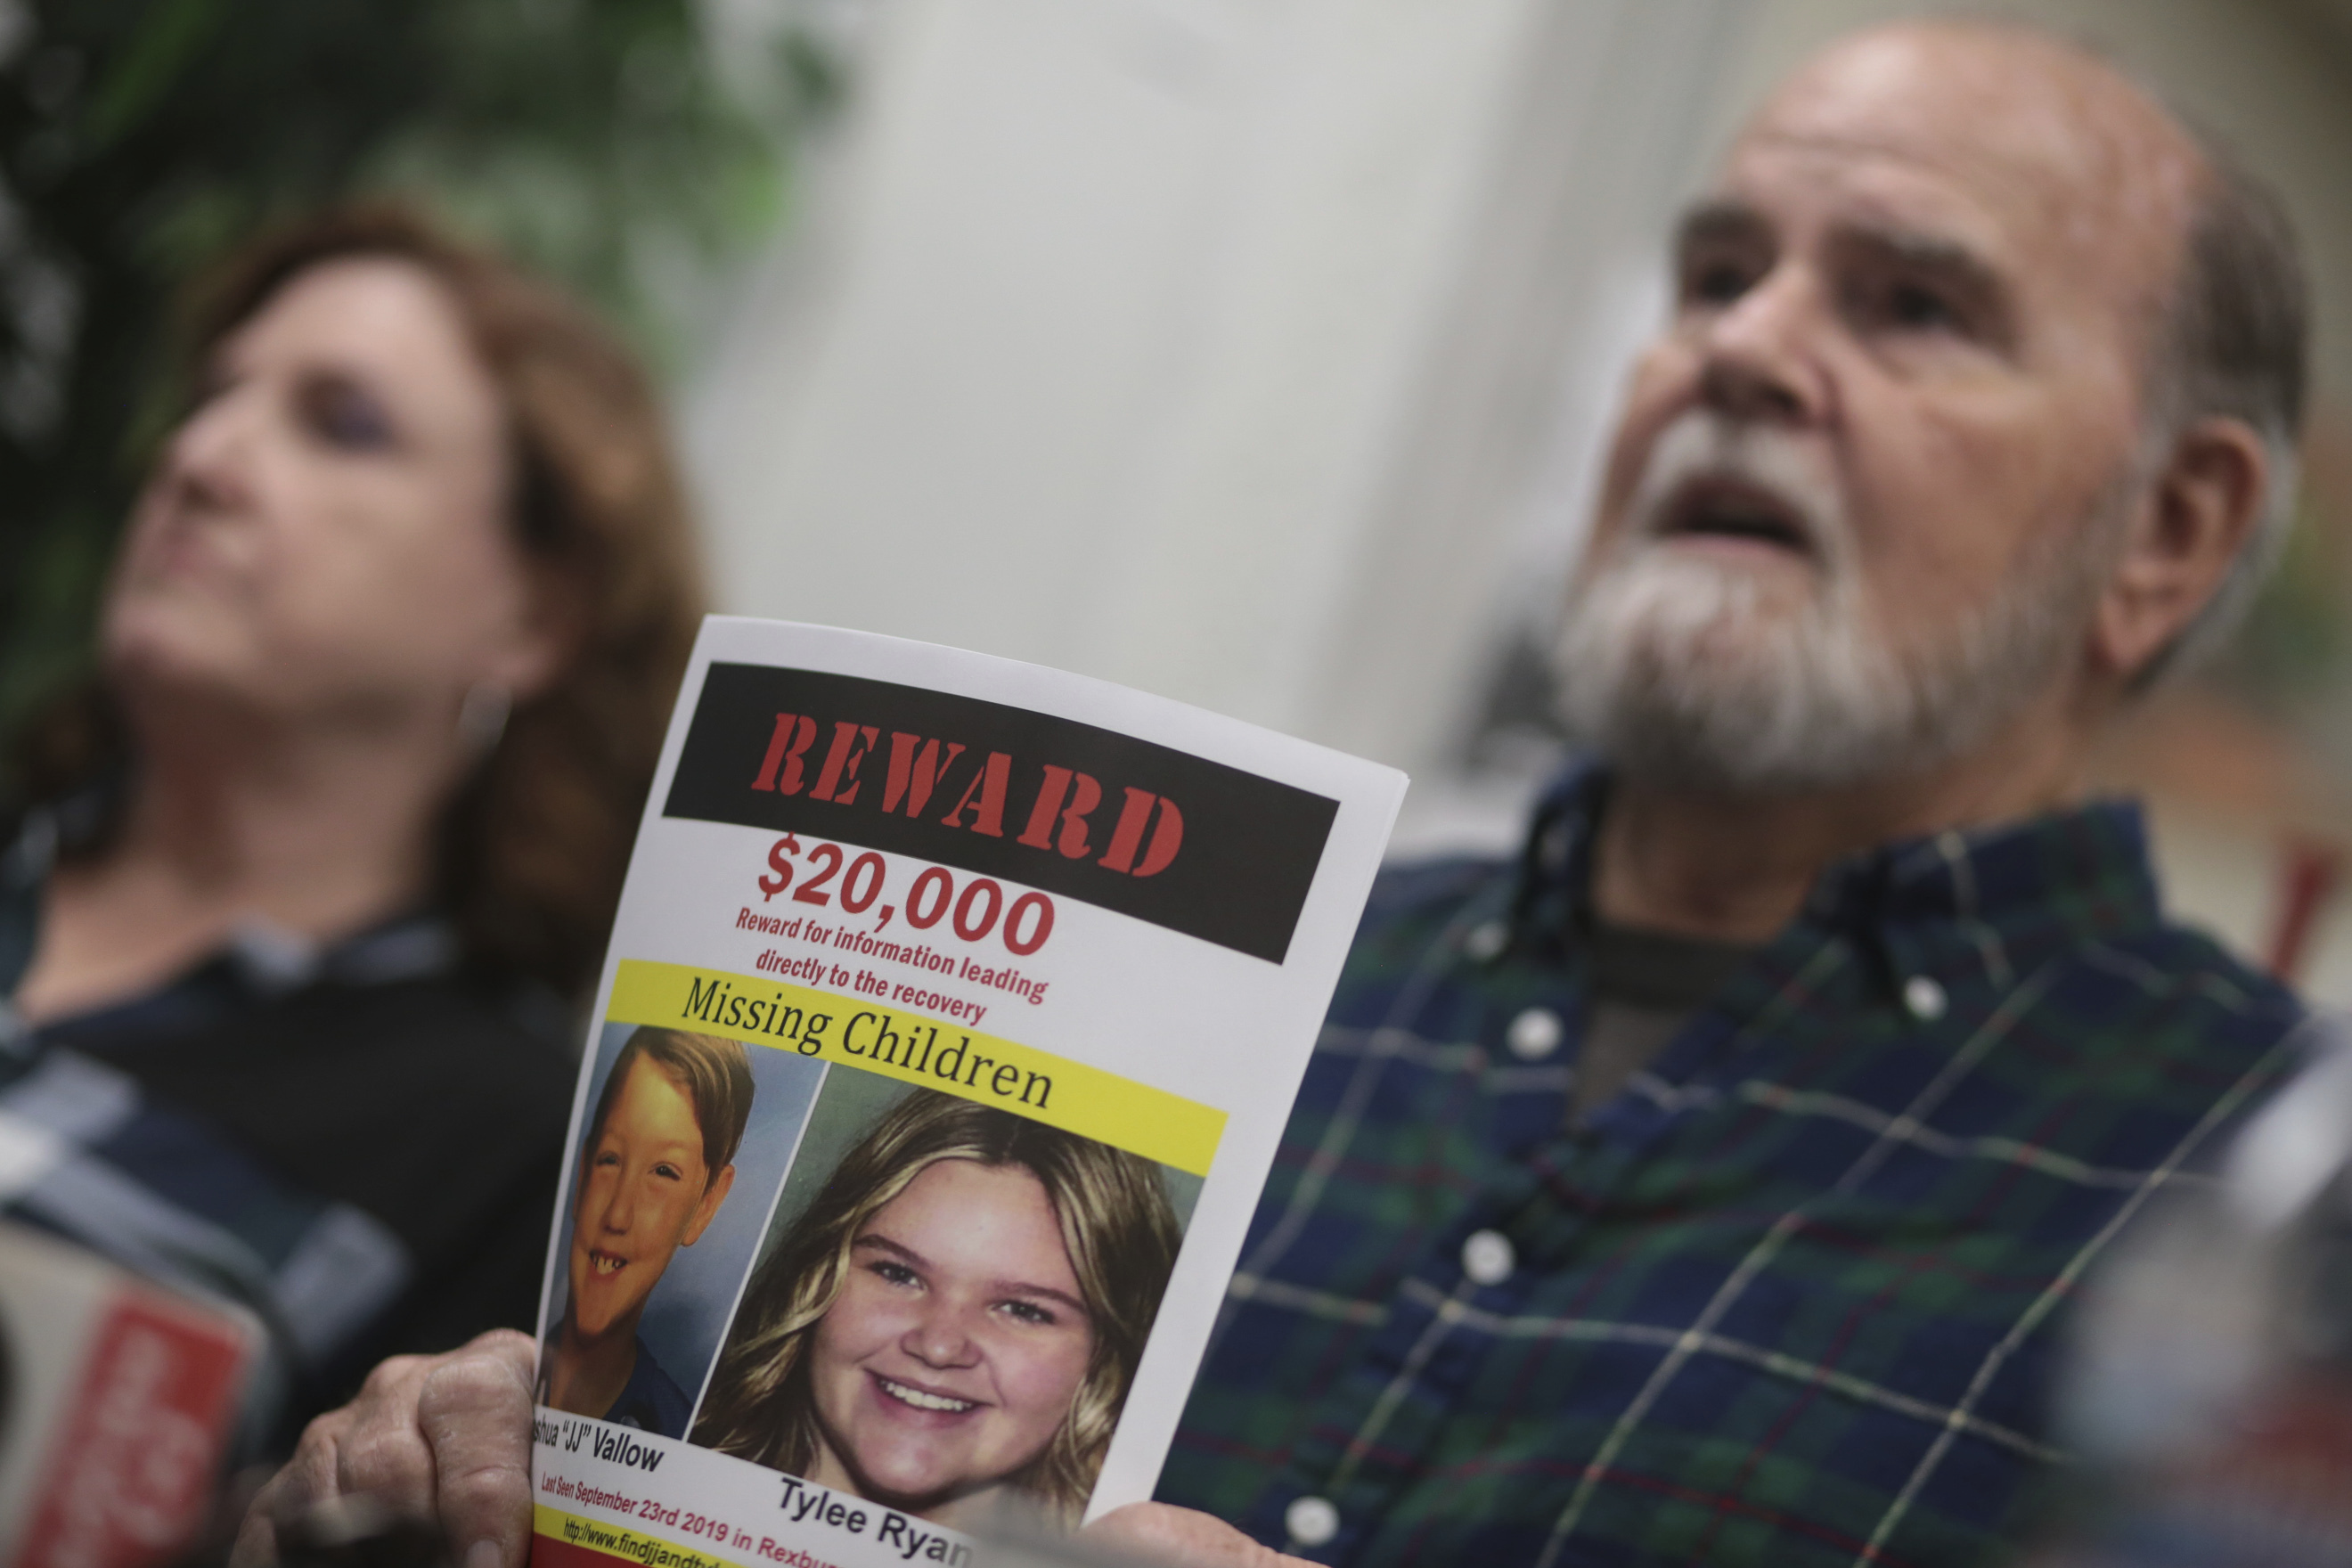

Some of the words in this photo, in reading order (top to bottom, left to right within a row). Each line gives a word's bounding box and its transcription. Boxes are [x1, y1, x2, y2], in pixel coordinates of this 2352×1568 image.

[751, 713, 1184, 878] REWARD
[758, 831, 1055, 956] $20,000
[735, 907, 803, 938] Reward
[803, 919, 833, 944] for
[833, 926, 955, 975] information
[959, 957, 1049, 1005] leading
[755, 949, 827, 986] directly
[829, 963, 850, 987] to
[853, 969, 888, 996] the
[892, 984, 987, 1026] recovery
[682, 976, 833, 1057] Missing
[842, 1011, 1053, 1109] Children
[593, 1426, 665, 1472] Vallow
[542, 1472, 557, 1493] Last
[556, 1475, 575, 1499] Seen
[576, 1481, 638, 1515] September
[638, 1499, 681, 1526] 23rd
[681, 1512, 729, 1541] 2019
[732, 1528, 753, 1550] in
[780, 1477, 867, 1533] Tylee
[878, 1512, 974, 1568] Ryan
